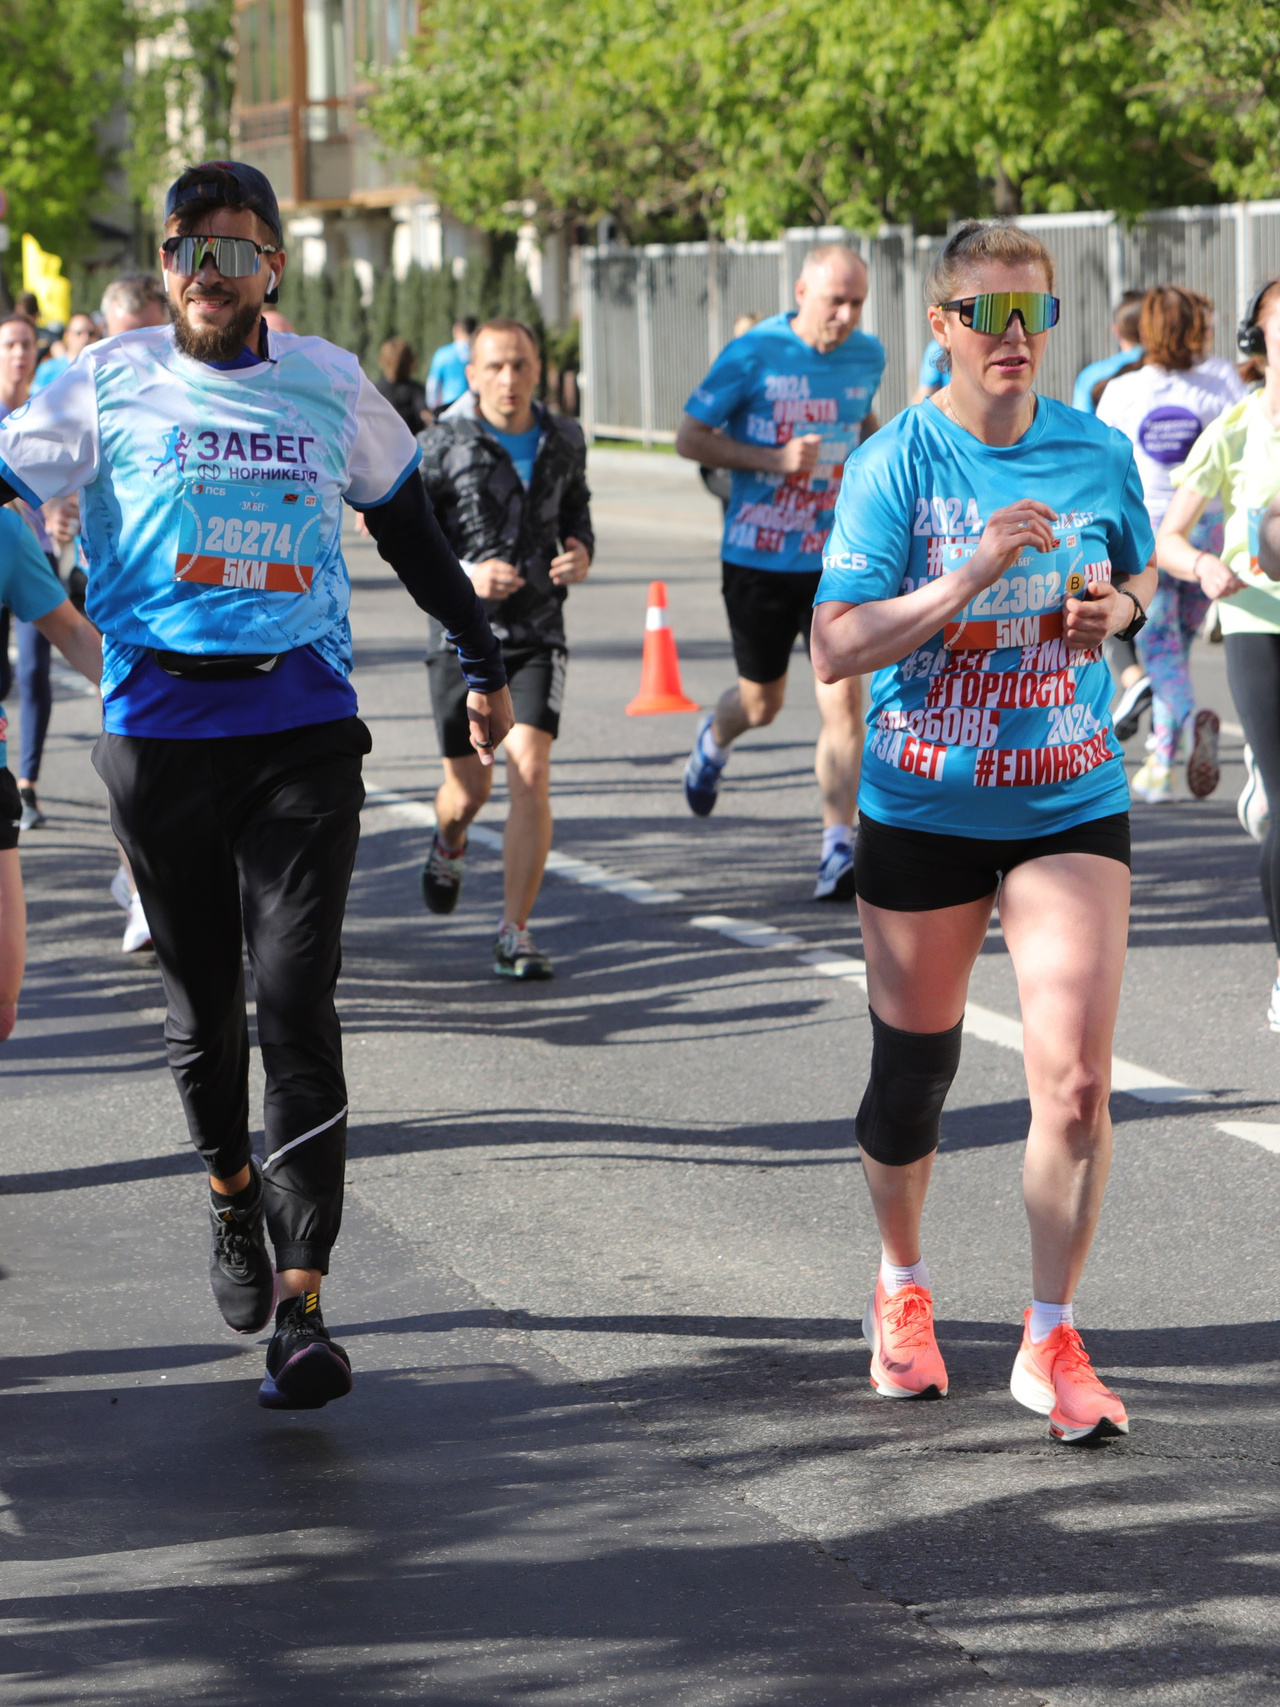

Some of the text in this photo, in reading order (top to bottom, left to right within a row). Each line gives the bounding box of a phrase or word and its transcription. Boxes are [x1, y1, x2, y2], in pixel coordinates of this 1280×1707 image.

[197, 431, 315, 464] ЗАБЕГ
[205, 486, 226, 496] ПСБ
[229, 467, 318, 484] НОРНИКЕЛЯ
[913, 496, 984, 536] 2024
[205, 516, 292, 559] 26274
[222, 558, 269, 590] 5КМ
[823, 552, 868, 570] ПСБ
[972, 571, 1062, 616] 22362
[1070, 576, 1080, 590] B
[996, 615, 1040, 648] 5КМ
[925, 668, 1077, 710] #ГОРДОСТЬ
[1046, 702, 1101, 746] 2024
[870, 727, 947, 781] #ЗАБЕГ
